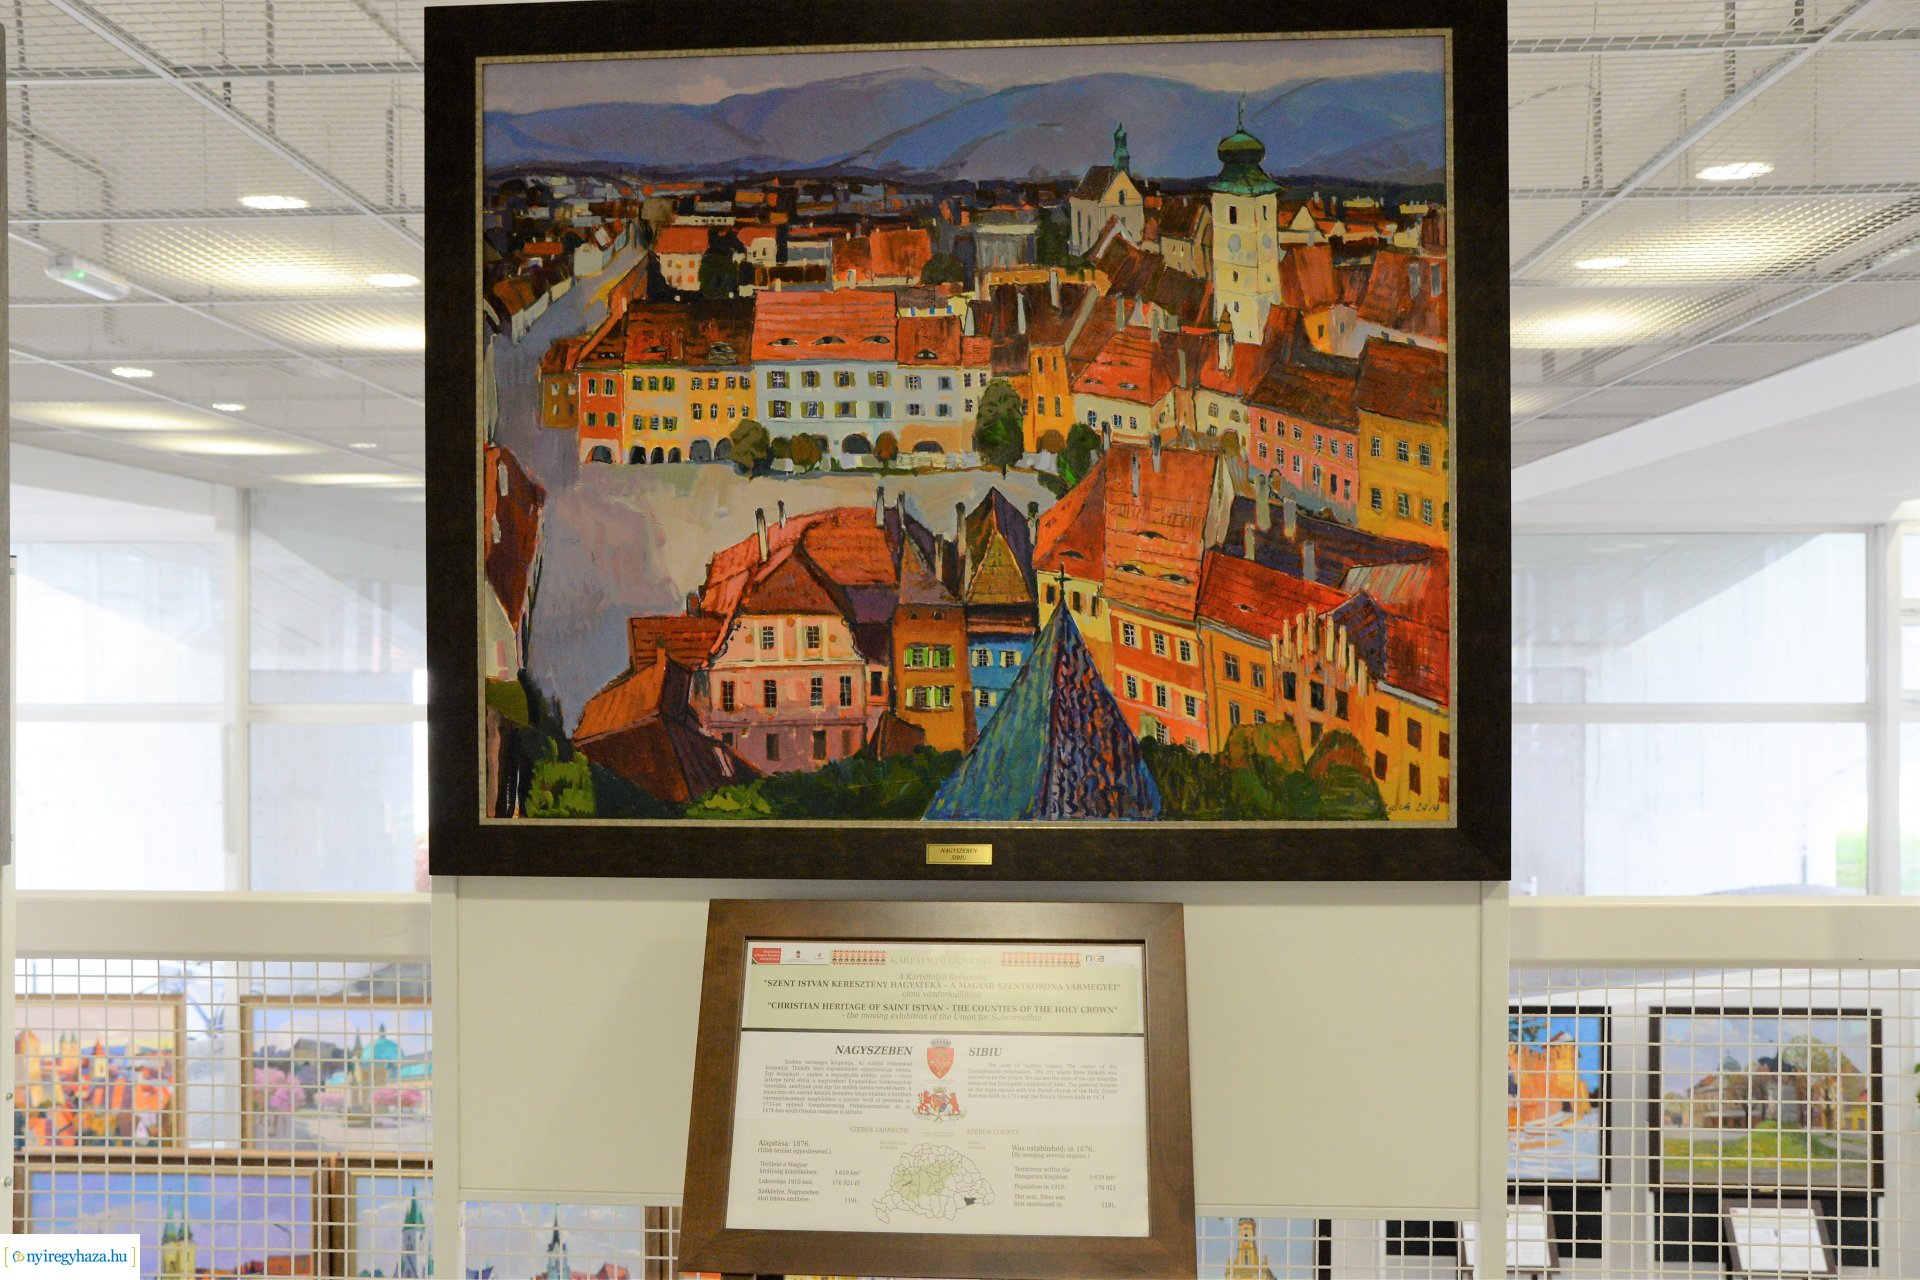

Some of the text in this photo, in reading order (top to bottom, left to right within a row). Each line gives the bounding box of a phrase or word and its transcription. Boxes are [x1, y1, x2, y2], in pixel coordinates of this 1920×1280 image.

[959, 982, 996, 990] MAGYAR
[767, 1002, 820, 1010] "CHRISTIAN
[951, 1004, 970, 1012] THE
[1034, 1005, 1053, 1013] THE
[846, 1011, 859, 1019] the
[861, 1012, 889, 1020] moving
[890, 1012, 928, 1020] exhibition
[929, 1012, 938, 1021] of
[978, 1013, 987, 1022] for
[834, 1045, 914, 1056] NAGYSZEBEN
[968, 1047, 1003, 1057] SIBIU
[1011, 1144, 1025, 1152] Was
